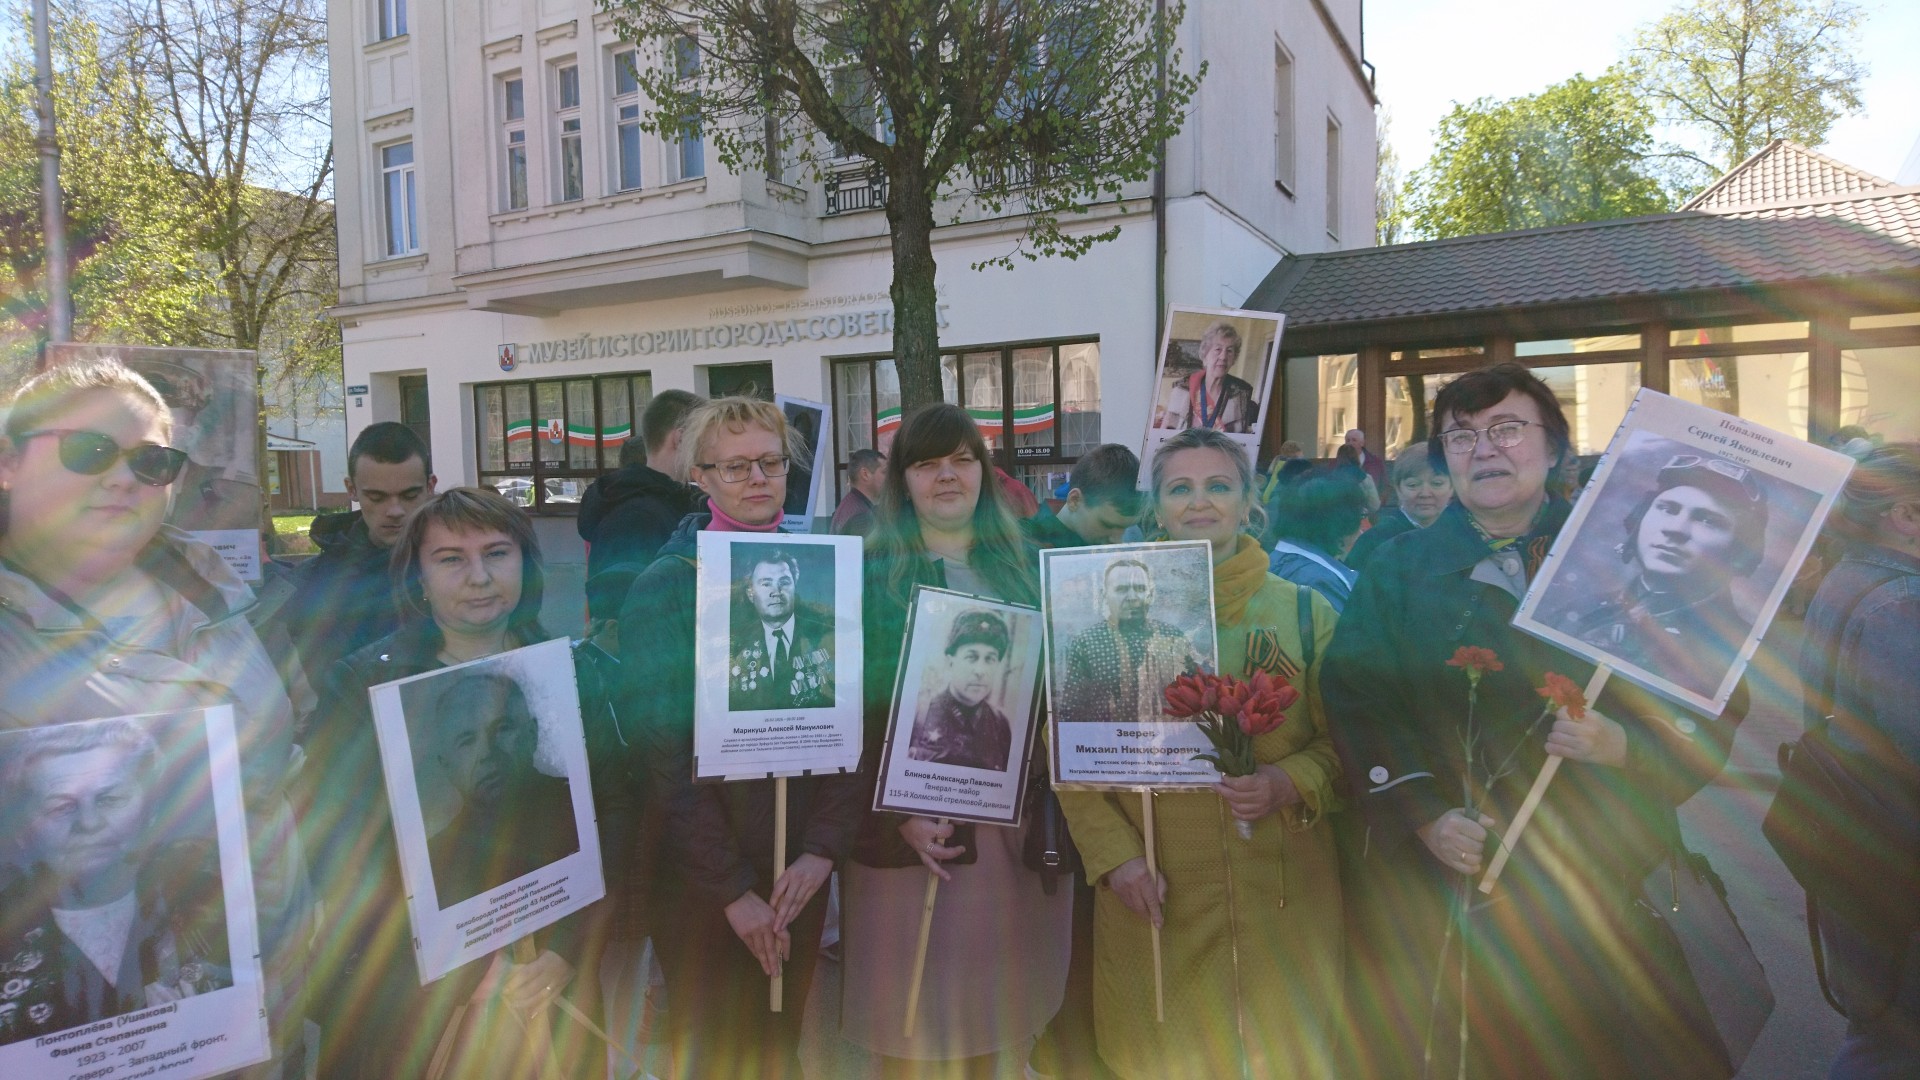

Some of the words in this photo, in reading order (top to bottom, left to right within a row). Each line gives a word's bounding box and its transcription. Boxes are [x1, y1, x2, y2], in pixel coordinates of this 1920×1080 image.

[708, 305, 760, 318] MUSEUM
[762, 303, 778, 314] OF
[784, 300, 809, 313] THE
[809, 292, 861, 310] HISTORY
[526, 333, 592, 364] МУЗЕЙ
[599, 327, 699, 359] ИСТОРИИ
[700, 318, 804, 351] ГОРОДА
[1719, 419, 1774, 446] Поваляев
[1687, 425, 1728, 446] Сергей
[1728, 439, 1793, 469] Яковлевич
[733, 727, 767, 735] Марикуца
[767, 725, 794, 733] Алексей
[795, 724, 835, 732] Мануилович
[1076, 745, 1118, 754] Михаил
[1121, 745, 1201, 757] Никифорович
[904, 769, 931, 779] Блинов
[931, 773, 969, 786] Александр
[969, 777, 1003, 789] Павлович
[924, 782, 951, 793] Генерал
[959, 787, 981, 797] майор
[889, 789, 909, 798] 115-й
[909, 791, 944, 802] Холмской
[943, 796, 982, 808] стрелковой
[982, 800, 1011, 810] дивизии
[489, 889, 517, 906] Генерал
[517, 879, 539, 892] Армии
[499, 893, 529, 911] Афанасий
[492, 919, 513, 935] Герой
[513, 904, 550, 924] Советского
[550, 894, 571, 908] Союза
[495, 903, 529, 923] командир
[529, 898, 539, 906] 43
[35, 1020, 113, 1048] Понтоплёва
[117, 1002, 178, 1028] (Ушакова)
[50, 1043, 93, 1059] Фаина
[95, 1021, 168, 1047] Степановна
[76, 1051, 107, 1068] 1923
[117, 1039, 147, 1056] 2007
[68, 1065, 115, 1080] Северо
[127, 1044, 188, 1068] Западный
[190, 1033, 229, 1051] фронт,
